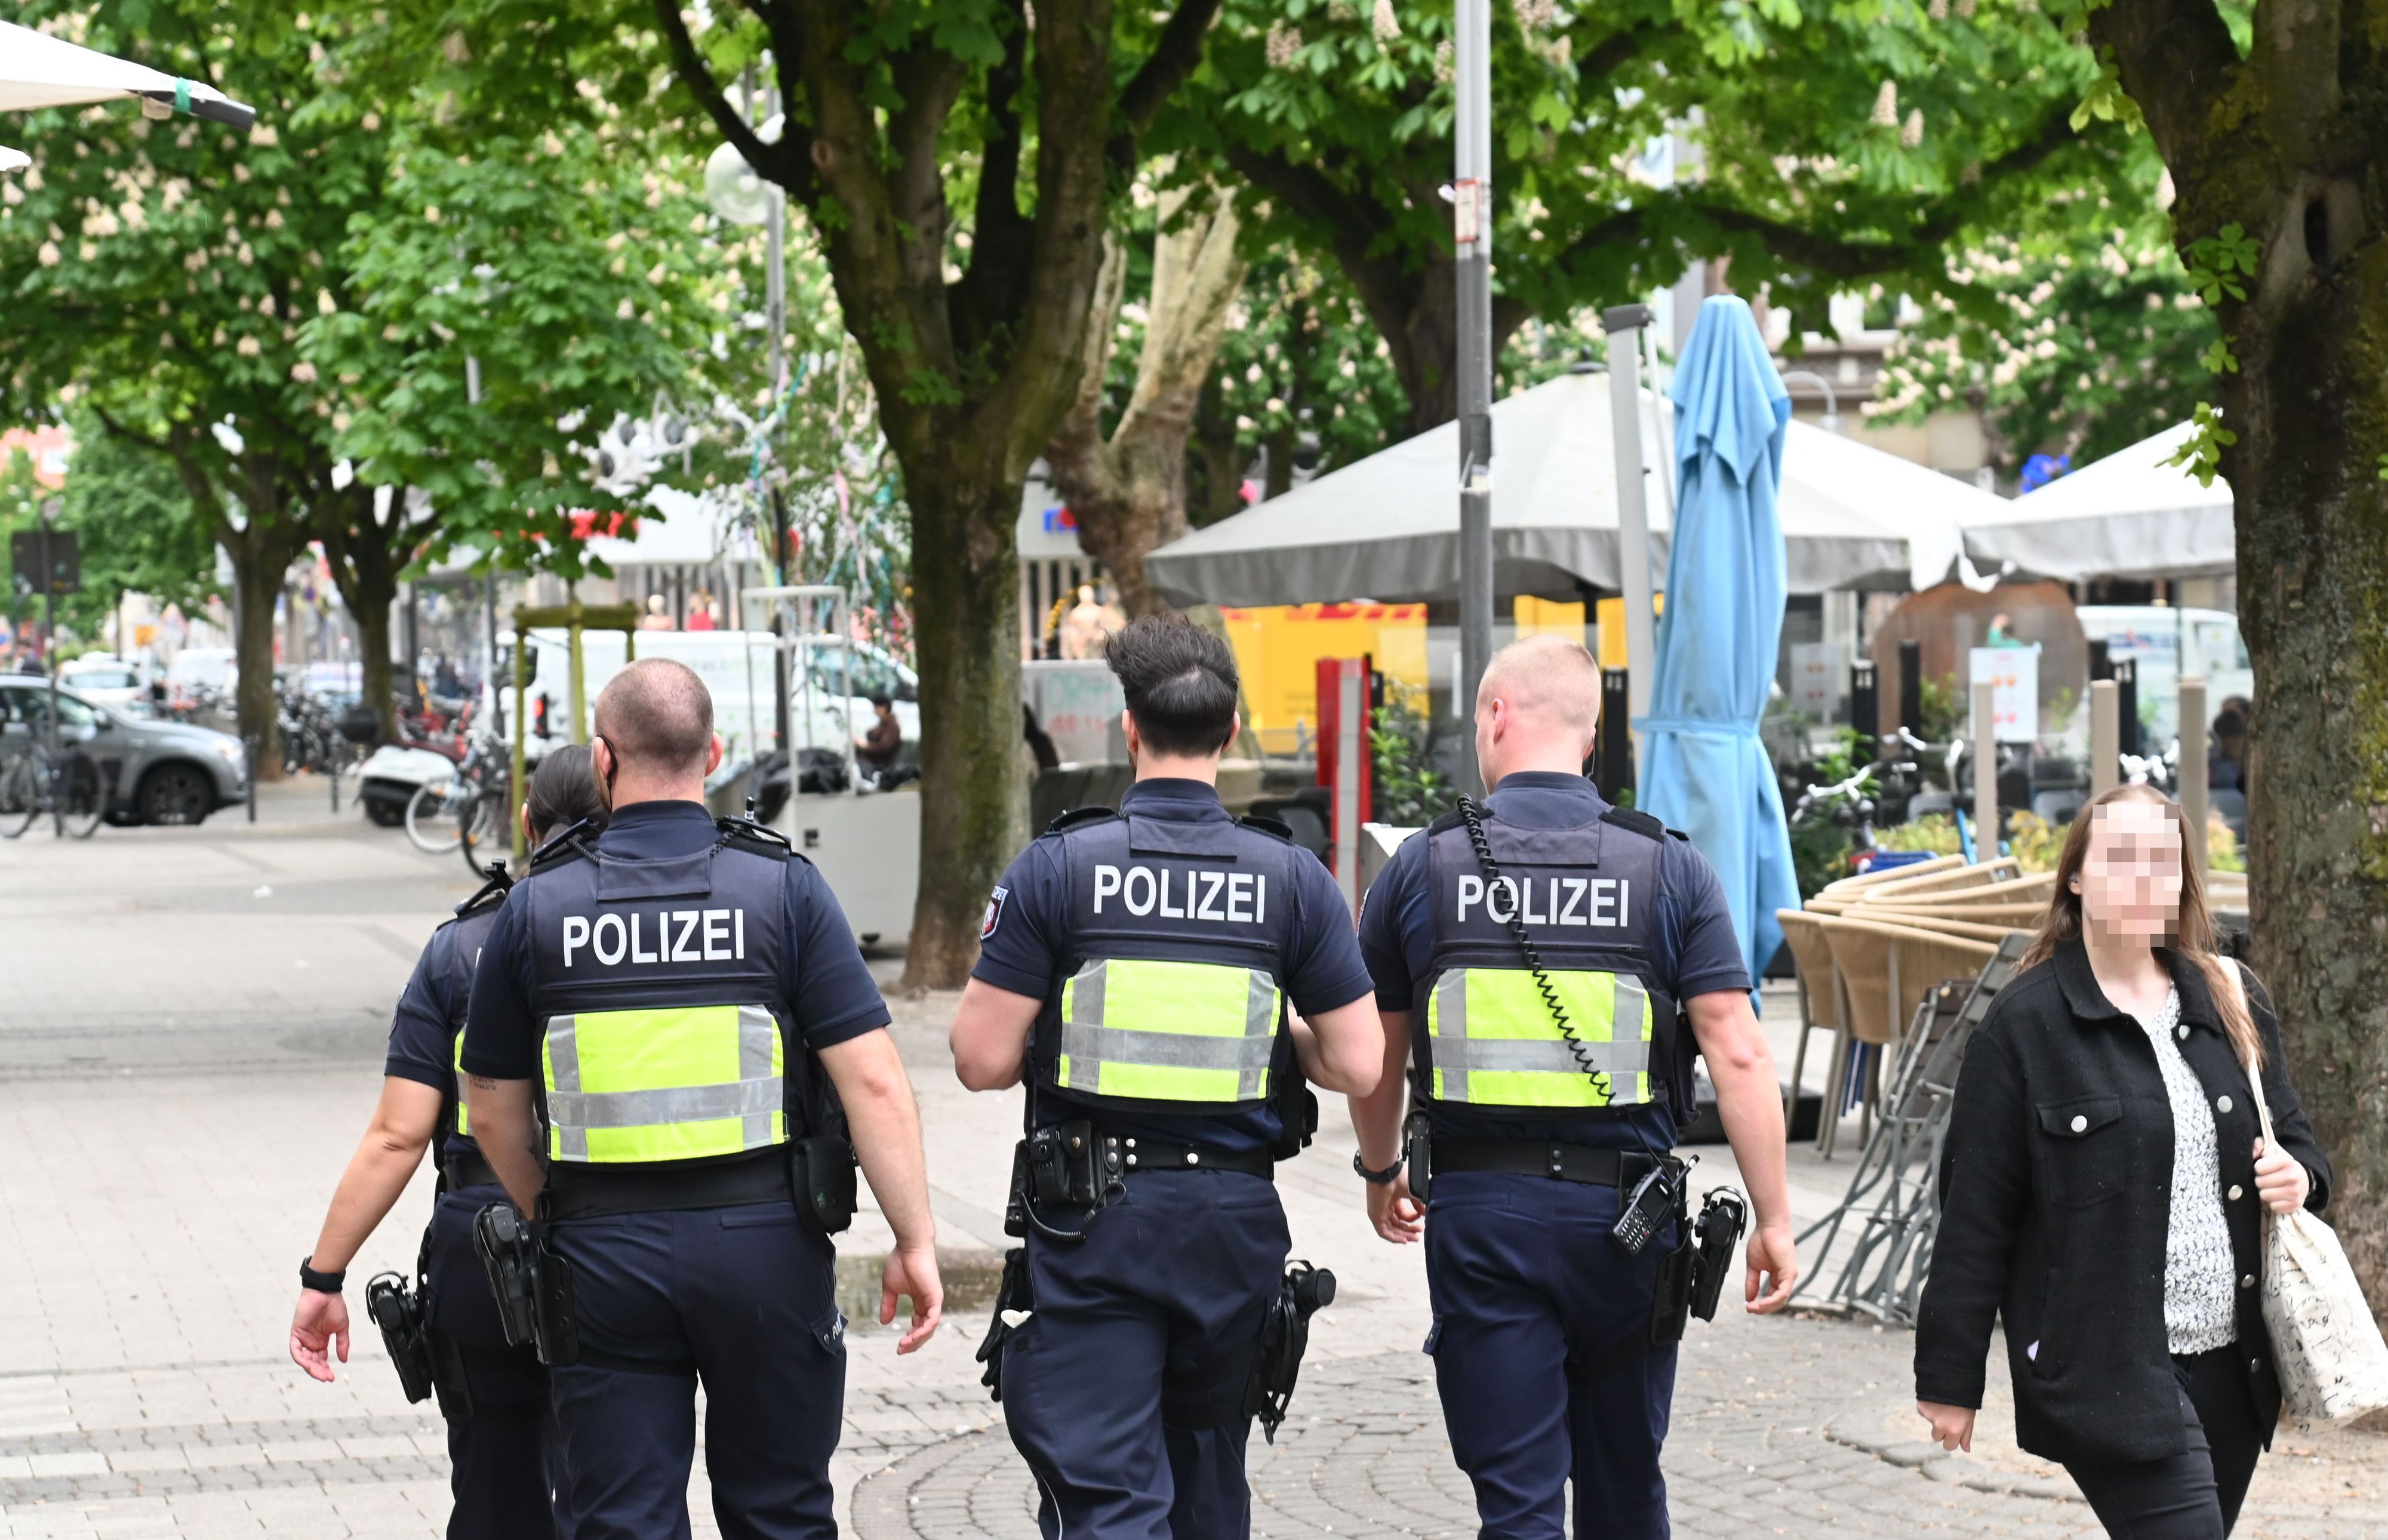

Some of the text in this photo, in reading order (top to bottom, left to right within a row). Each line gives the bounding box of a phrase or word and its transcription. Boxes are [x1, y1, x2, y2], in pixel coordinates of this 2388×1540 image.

[1094, 864, 1266, 924] POLIZEI
[1458, 874, 1629, 928] POLIZEI
[563, 908, 744, 968] POLIZEI
